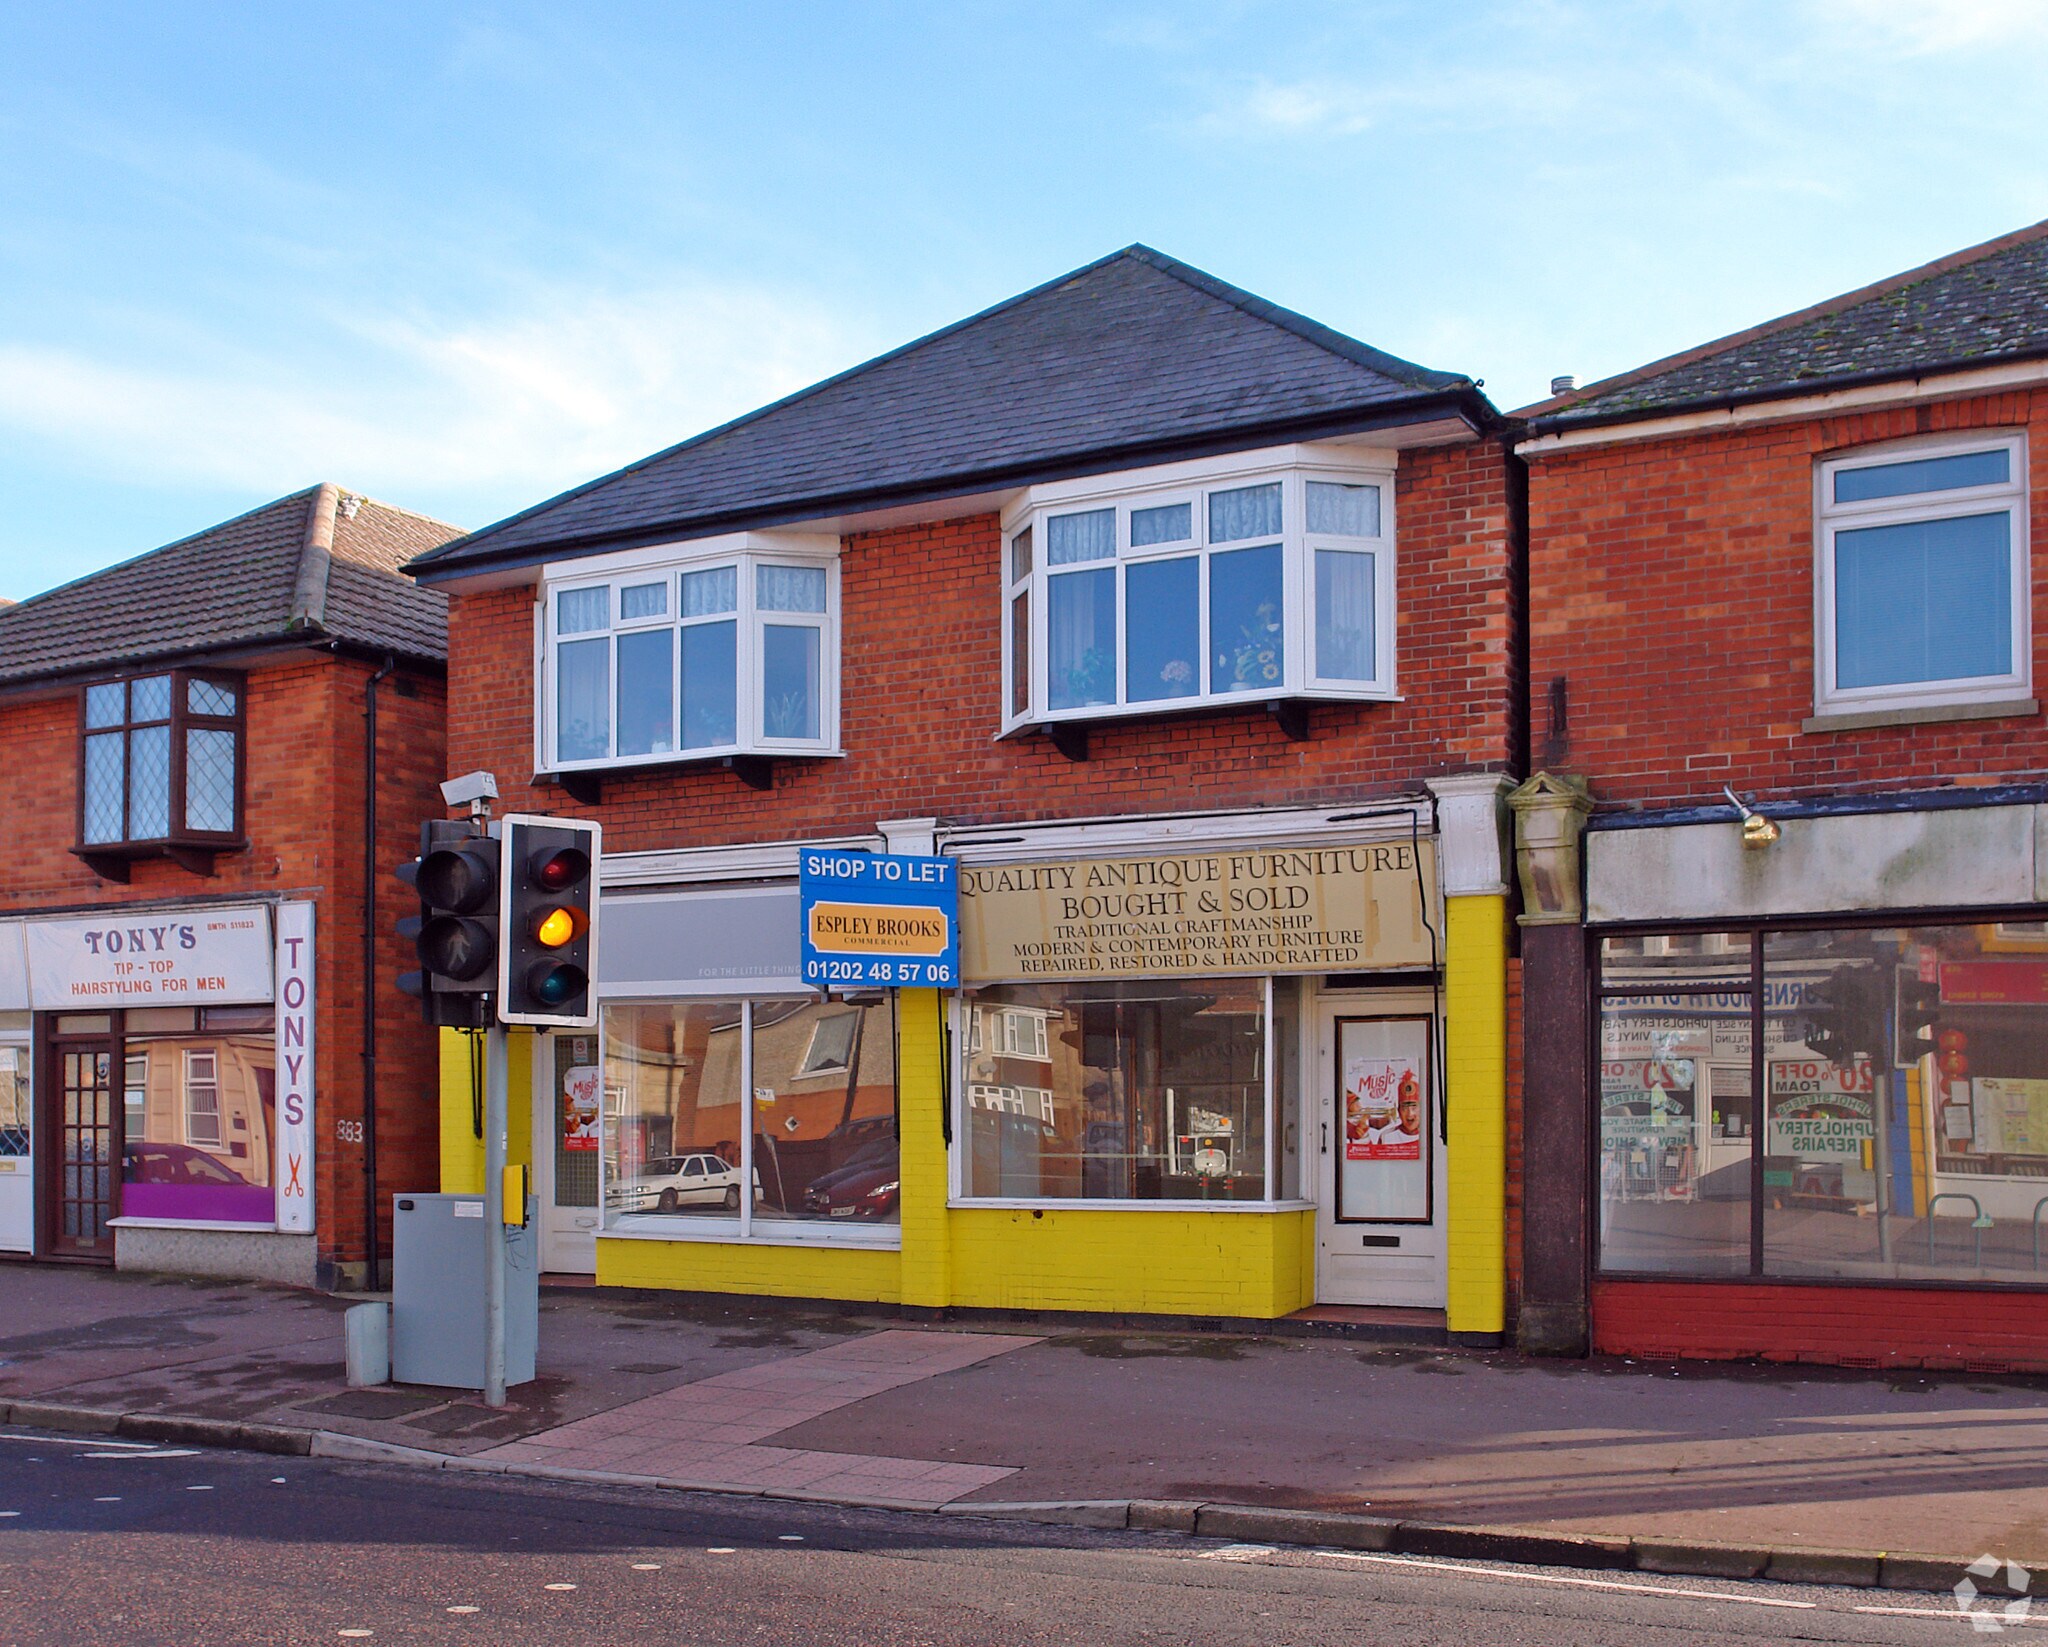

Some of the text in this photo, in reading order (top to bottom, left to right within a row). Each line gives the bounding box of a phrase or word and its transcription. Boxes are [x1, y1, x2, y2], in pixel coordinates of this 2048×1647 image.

[808, 856, 948, 882] SHOP TO LET
[961, 846, 1413, 897] QUALITY ANTIQUE FURNITURE
[1061, 886, 1308, 919] BOUGHT & SOLD
[816, 915, 940, 936] ESPLEY BROOKS
[1054, 914, 1312, 938] TRADITIONAL CRAFTMANSHIP
[84, 923, 196, 954] TONY'S
[844, 937, 910, 946] COMMERCIAL
[1014, 930, 1364, 956] MODERN & CONTEMPORARY FURNITURE
[114, 962, 134, 974] TIP
[149, 960, 174, 973] TOP
[698, 968, 718, 976] FOR
[720, 967, 736, 976] THE
[740, 966, 768, 975] LITTLE
[808, 960, 950, 982] 01202 48 57 06
[1021, 948, 1358, 972] REPAIRED, RESTORED & HANDCRAFTED
[72, 977, 226, 995] HAIRSTYLING FOR MEN
[284, 938, 305, 1125] TONYS
[337, 1120, 363, 1142] 883
